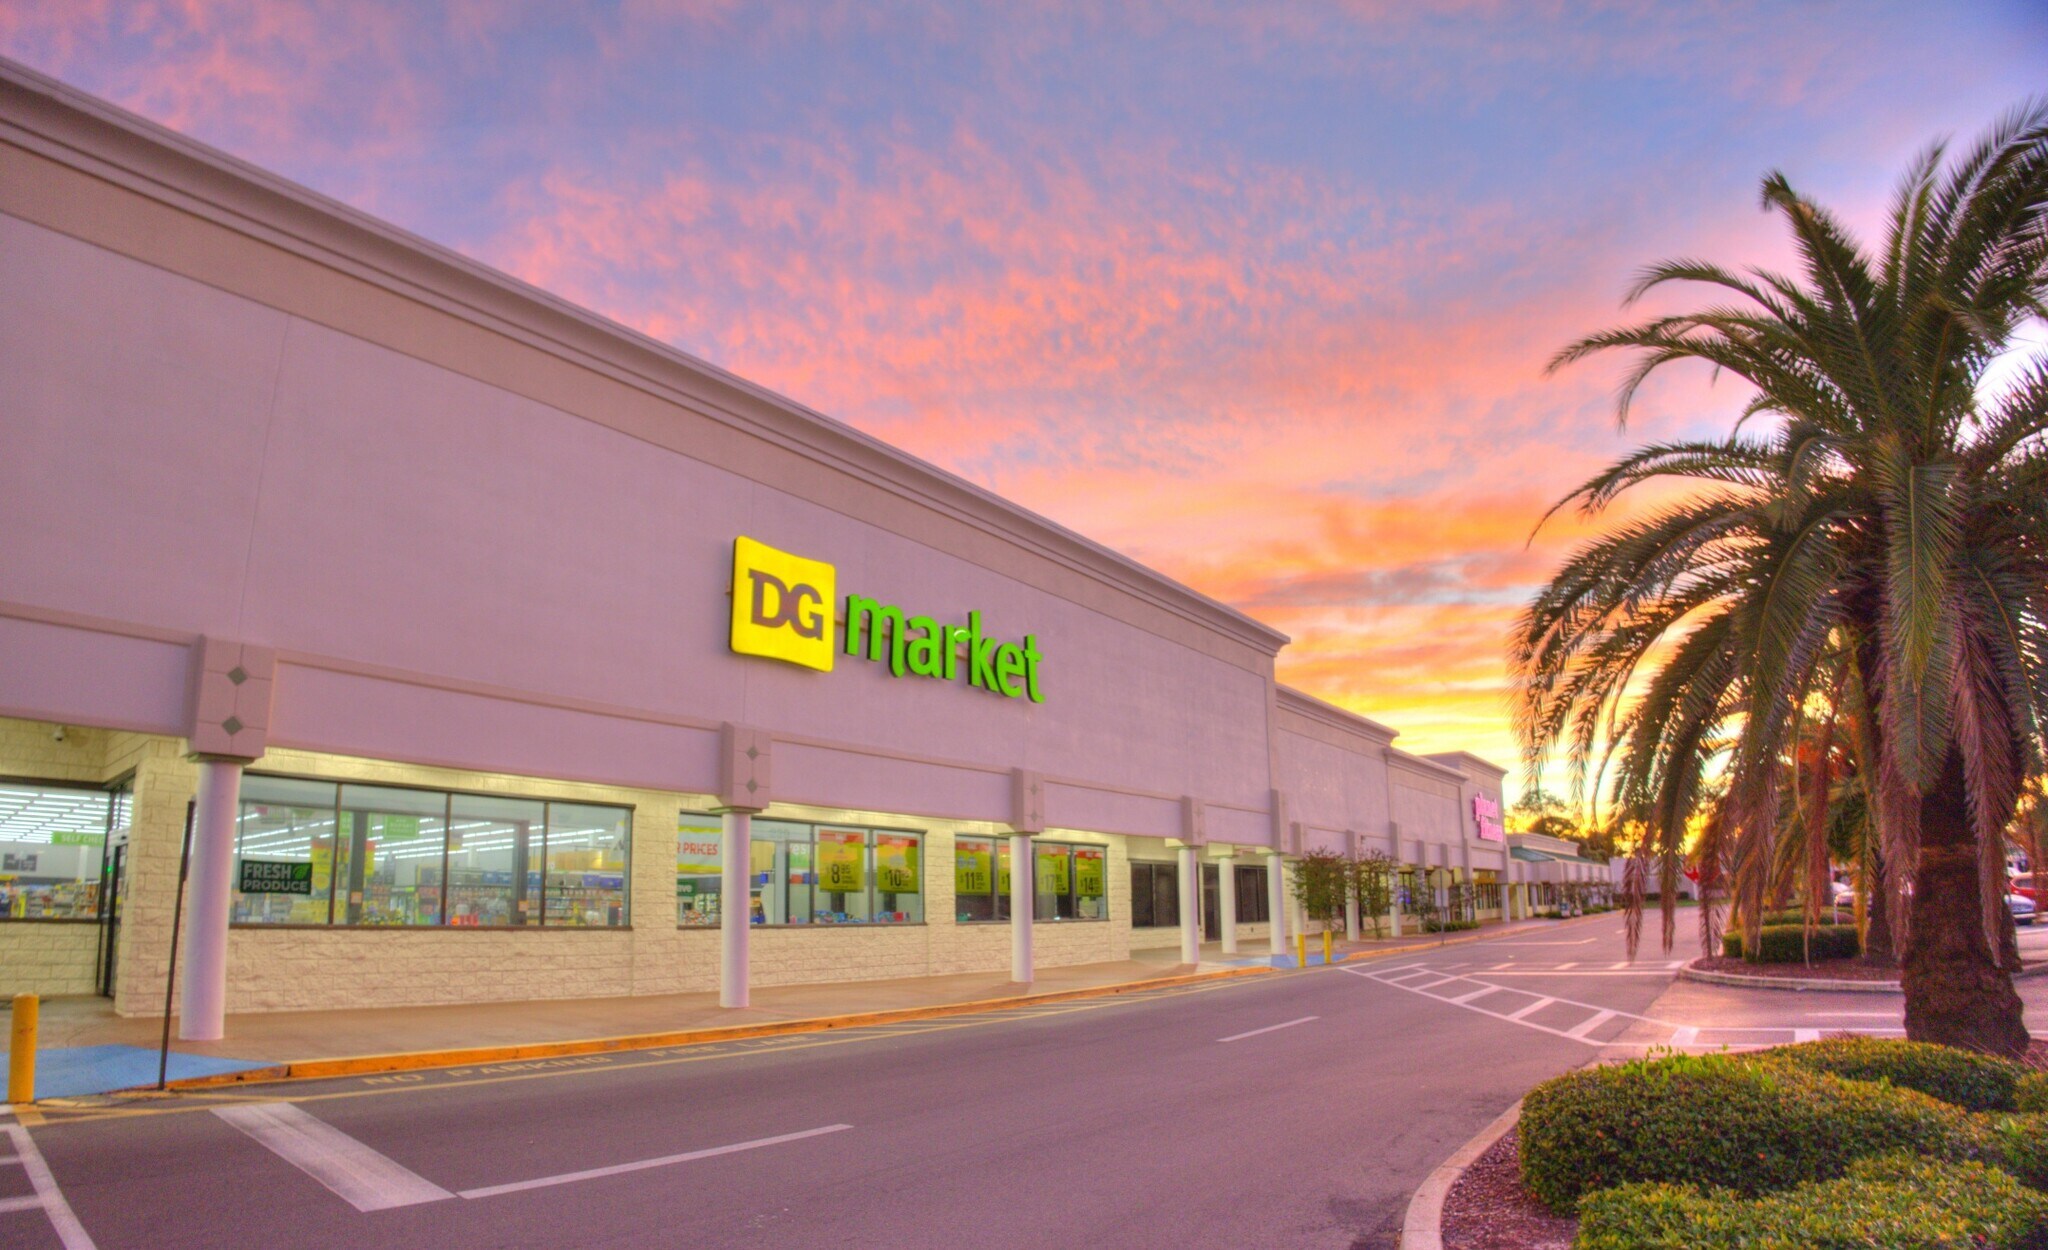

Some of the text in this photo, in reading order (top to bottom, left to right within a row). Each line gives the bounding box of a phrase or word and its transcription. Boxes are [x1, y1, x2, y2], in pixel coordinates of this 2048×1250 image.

[748, 568, 1045, 703] DG market
[683, 842, 718, 855] PRICES
[243, 863, 291, 879] FRESH
[243, 880, 308, 891] PRODUCE
[363, 1074, 424, 1085] NO
[446, 1056, 613, 1077] PARKING
[737, 1036, 818, 1047] LANE
